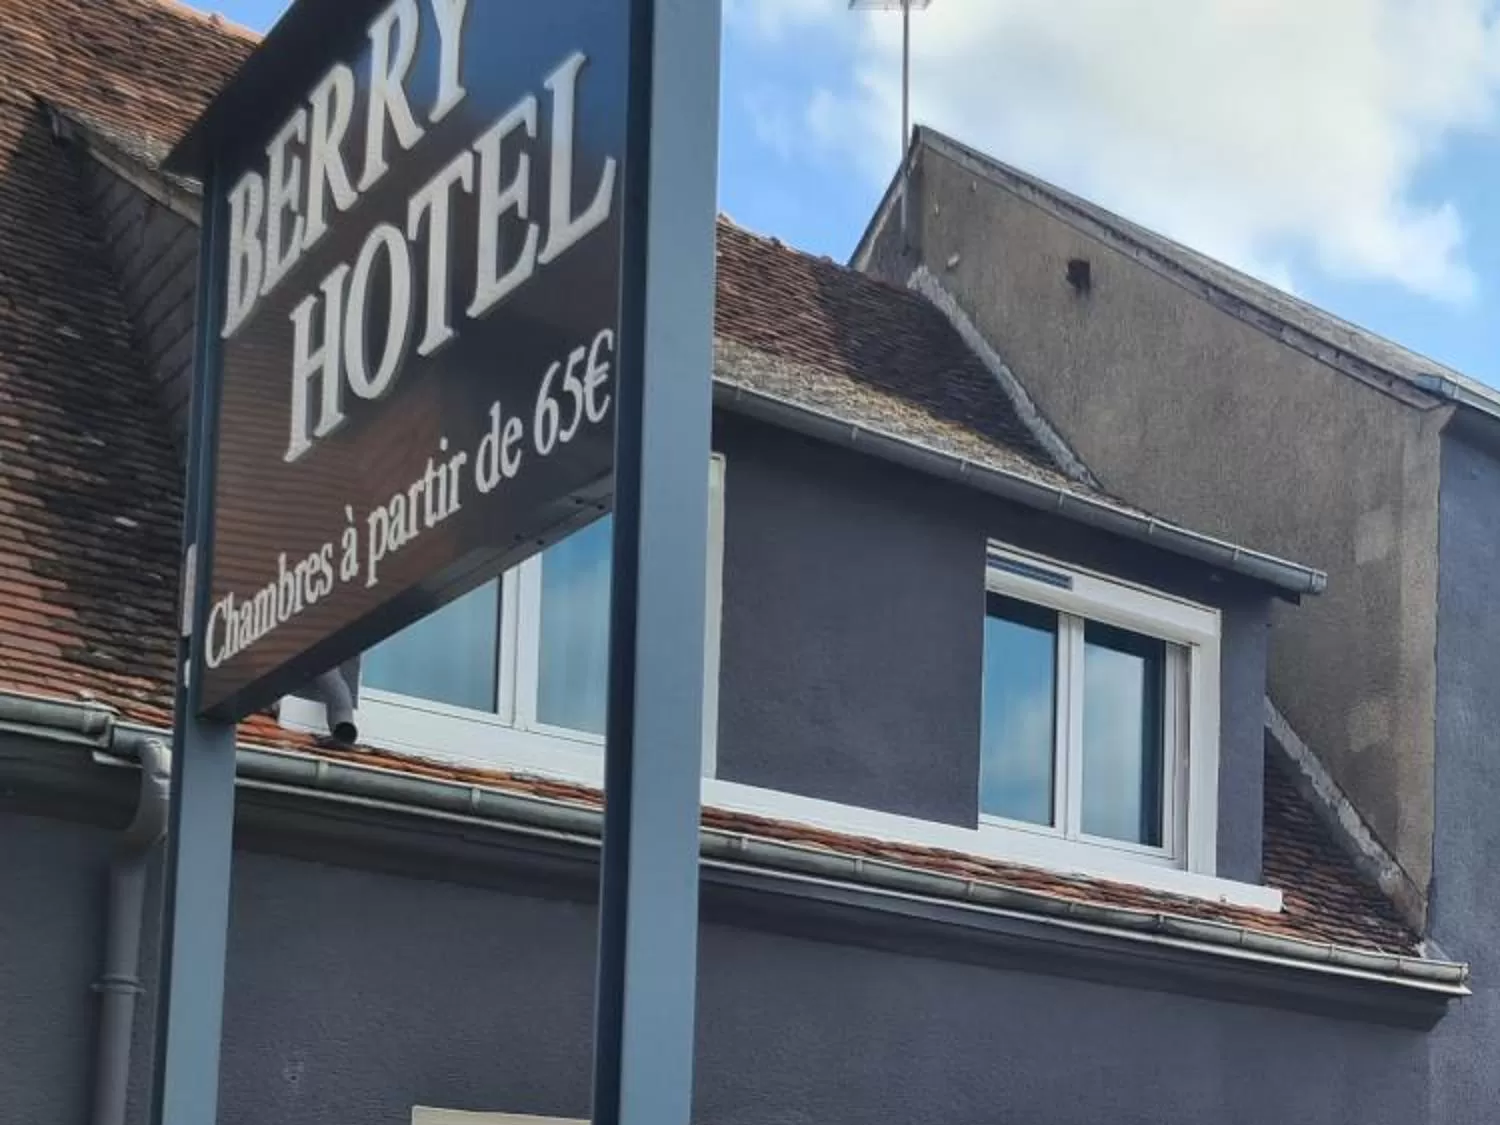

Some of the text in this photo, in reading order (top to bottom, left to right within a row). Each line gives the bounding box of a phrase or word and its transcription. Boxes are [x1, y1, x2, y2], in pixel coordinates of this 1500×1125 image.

[221, 0, 468, 339] BERRY
[284, 50, 617, 464] HOTEL
[204, 329, 615, 669] Chambres à partir de 65€
